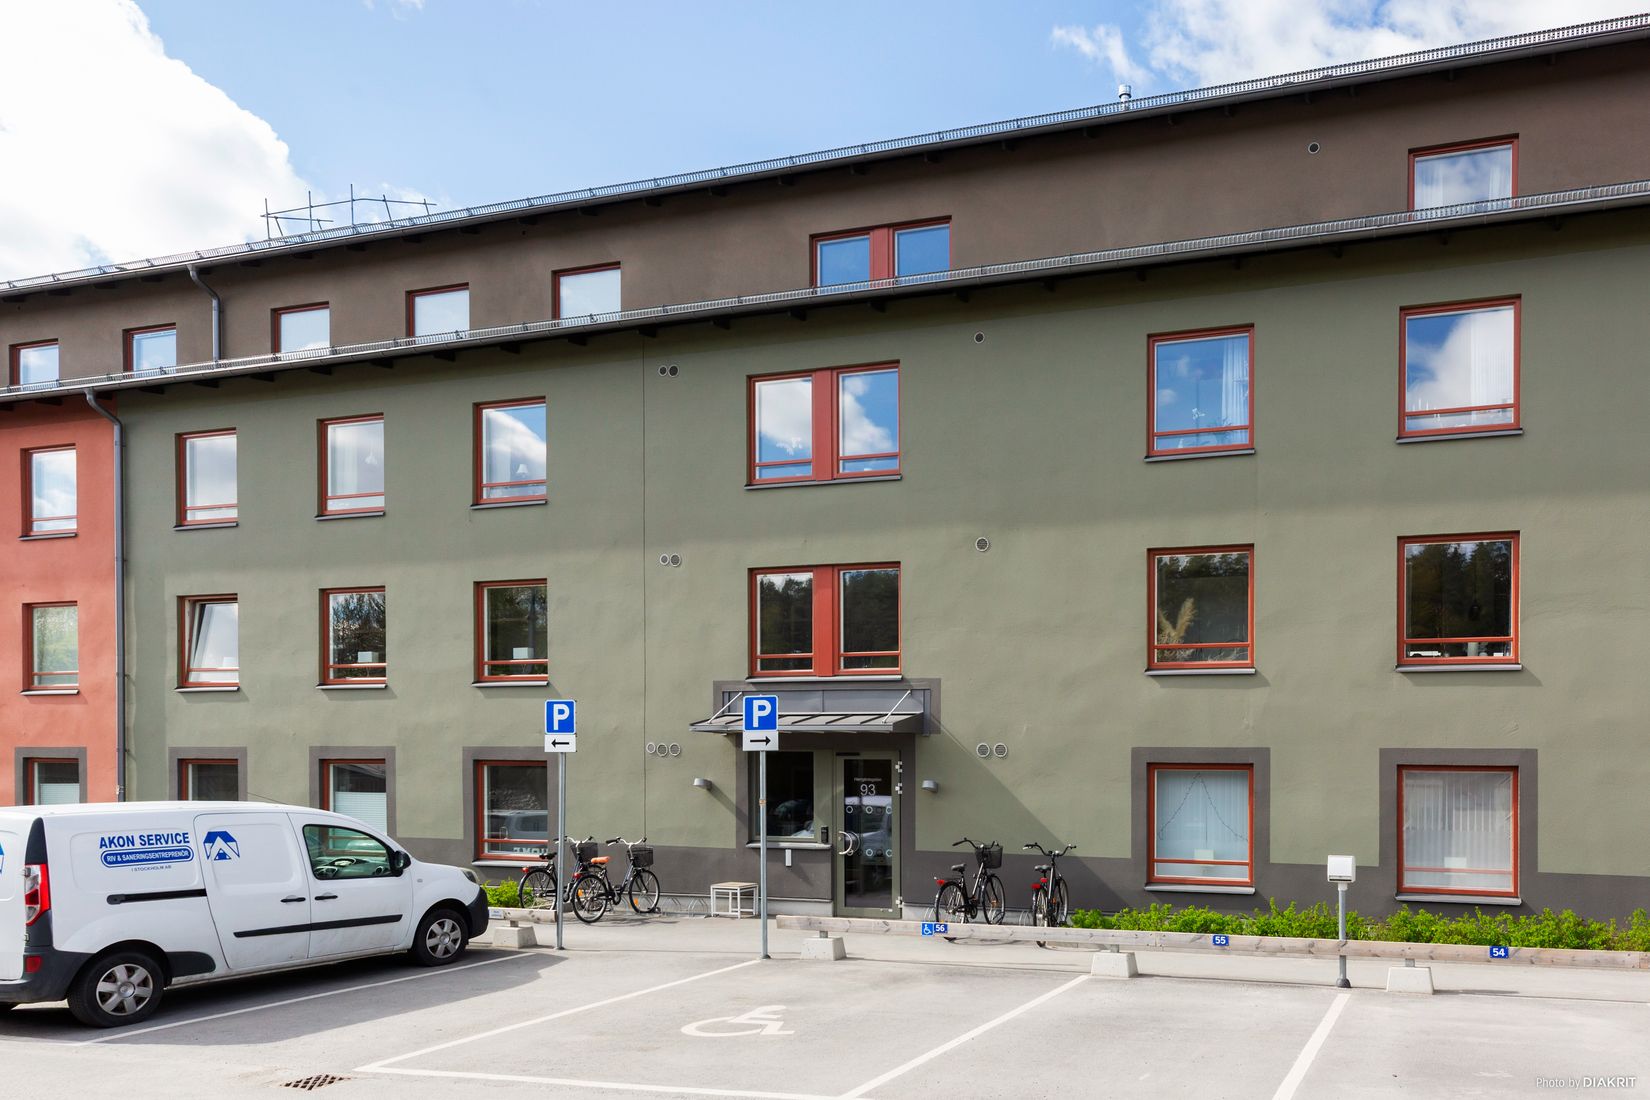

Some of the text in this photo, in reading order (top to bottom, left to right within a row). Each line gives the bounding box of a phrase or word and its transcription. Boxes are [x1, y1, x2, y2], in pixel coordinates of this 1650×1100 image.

[553, 703, 570, 731] P
[752, 699, 772, 728] P
[860, 783, 876, 796] 93
[99, 832, 190, 849] AKON SERVICE
[106, 850, 190, 863] RIV & SANERINGSENTREPRENÖR
[935, 924, 946, 932] 56
[1215, 935, 1226, 945] 55
[1492, 947, 1506, 957] 54
